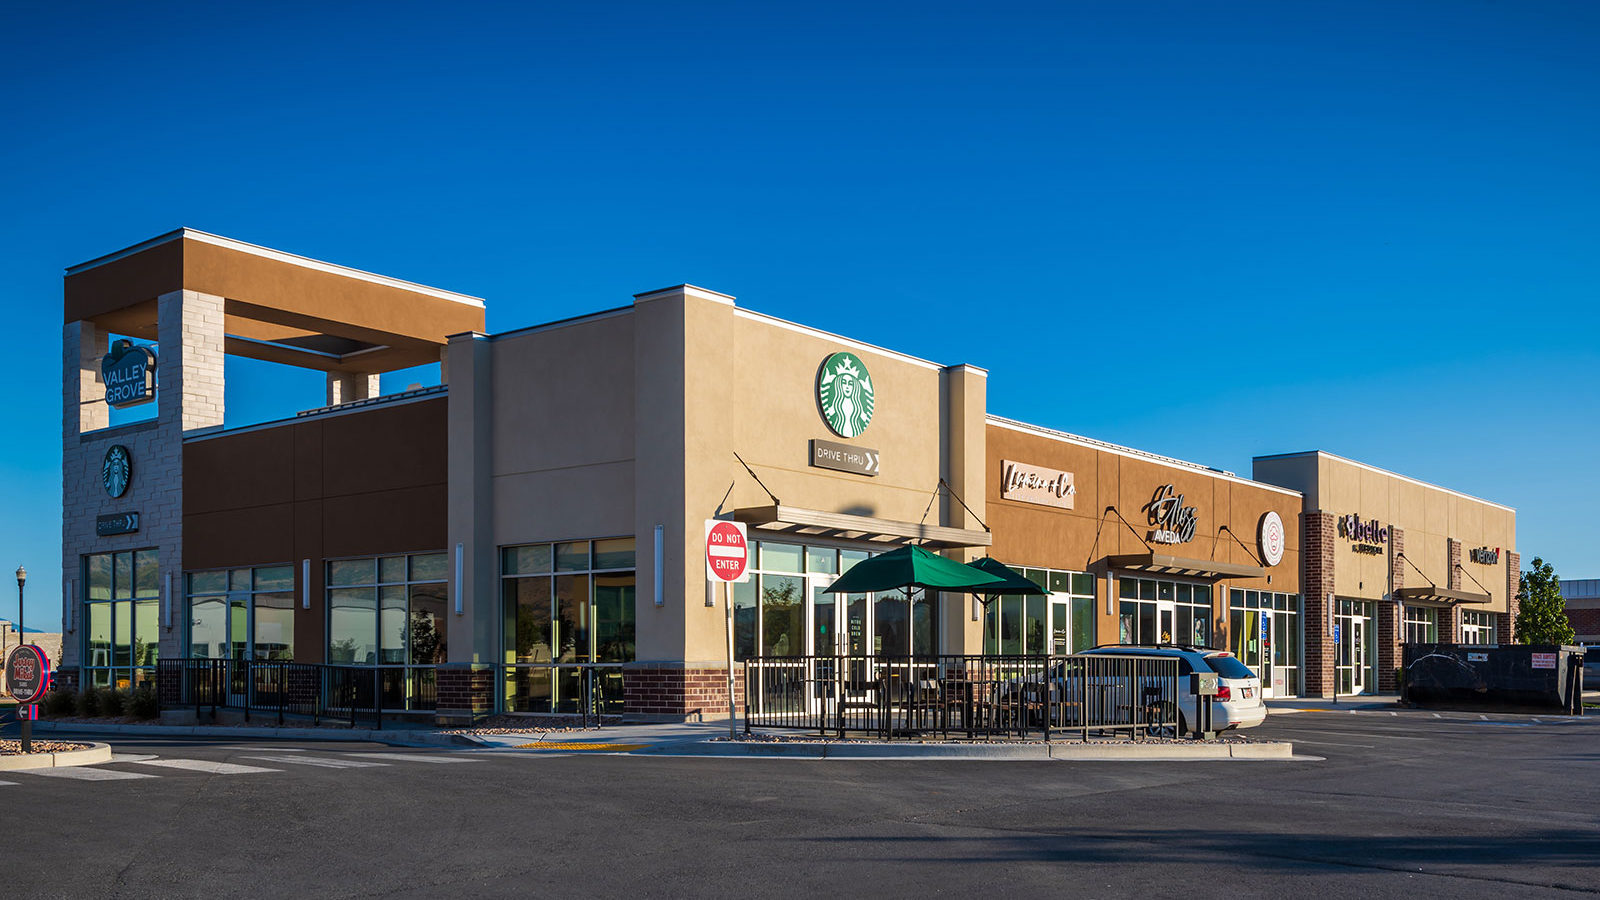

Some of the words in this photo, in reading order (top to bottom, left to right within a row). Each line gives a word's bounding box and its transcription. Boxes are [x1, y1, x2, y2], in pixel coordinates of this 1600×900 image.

[103, 362, 147, 386] VALLEY
[106, 381, 145, 403] GROVE
[817, 447, 841, 462] DRIVE
[843, 452, 864, 466] THRU
[712, 532, 723, 543] DO
[726, 533, 741, 544] NOT
[1154, 529, 1182, 544] AVEDA
[716, 559, 740, 570] ENTER
